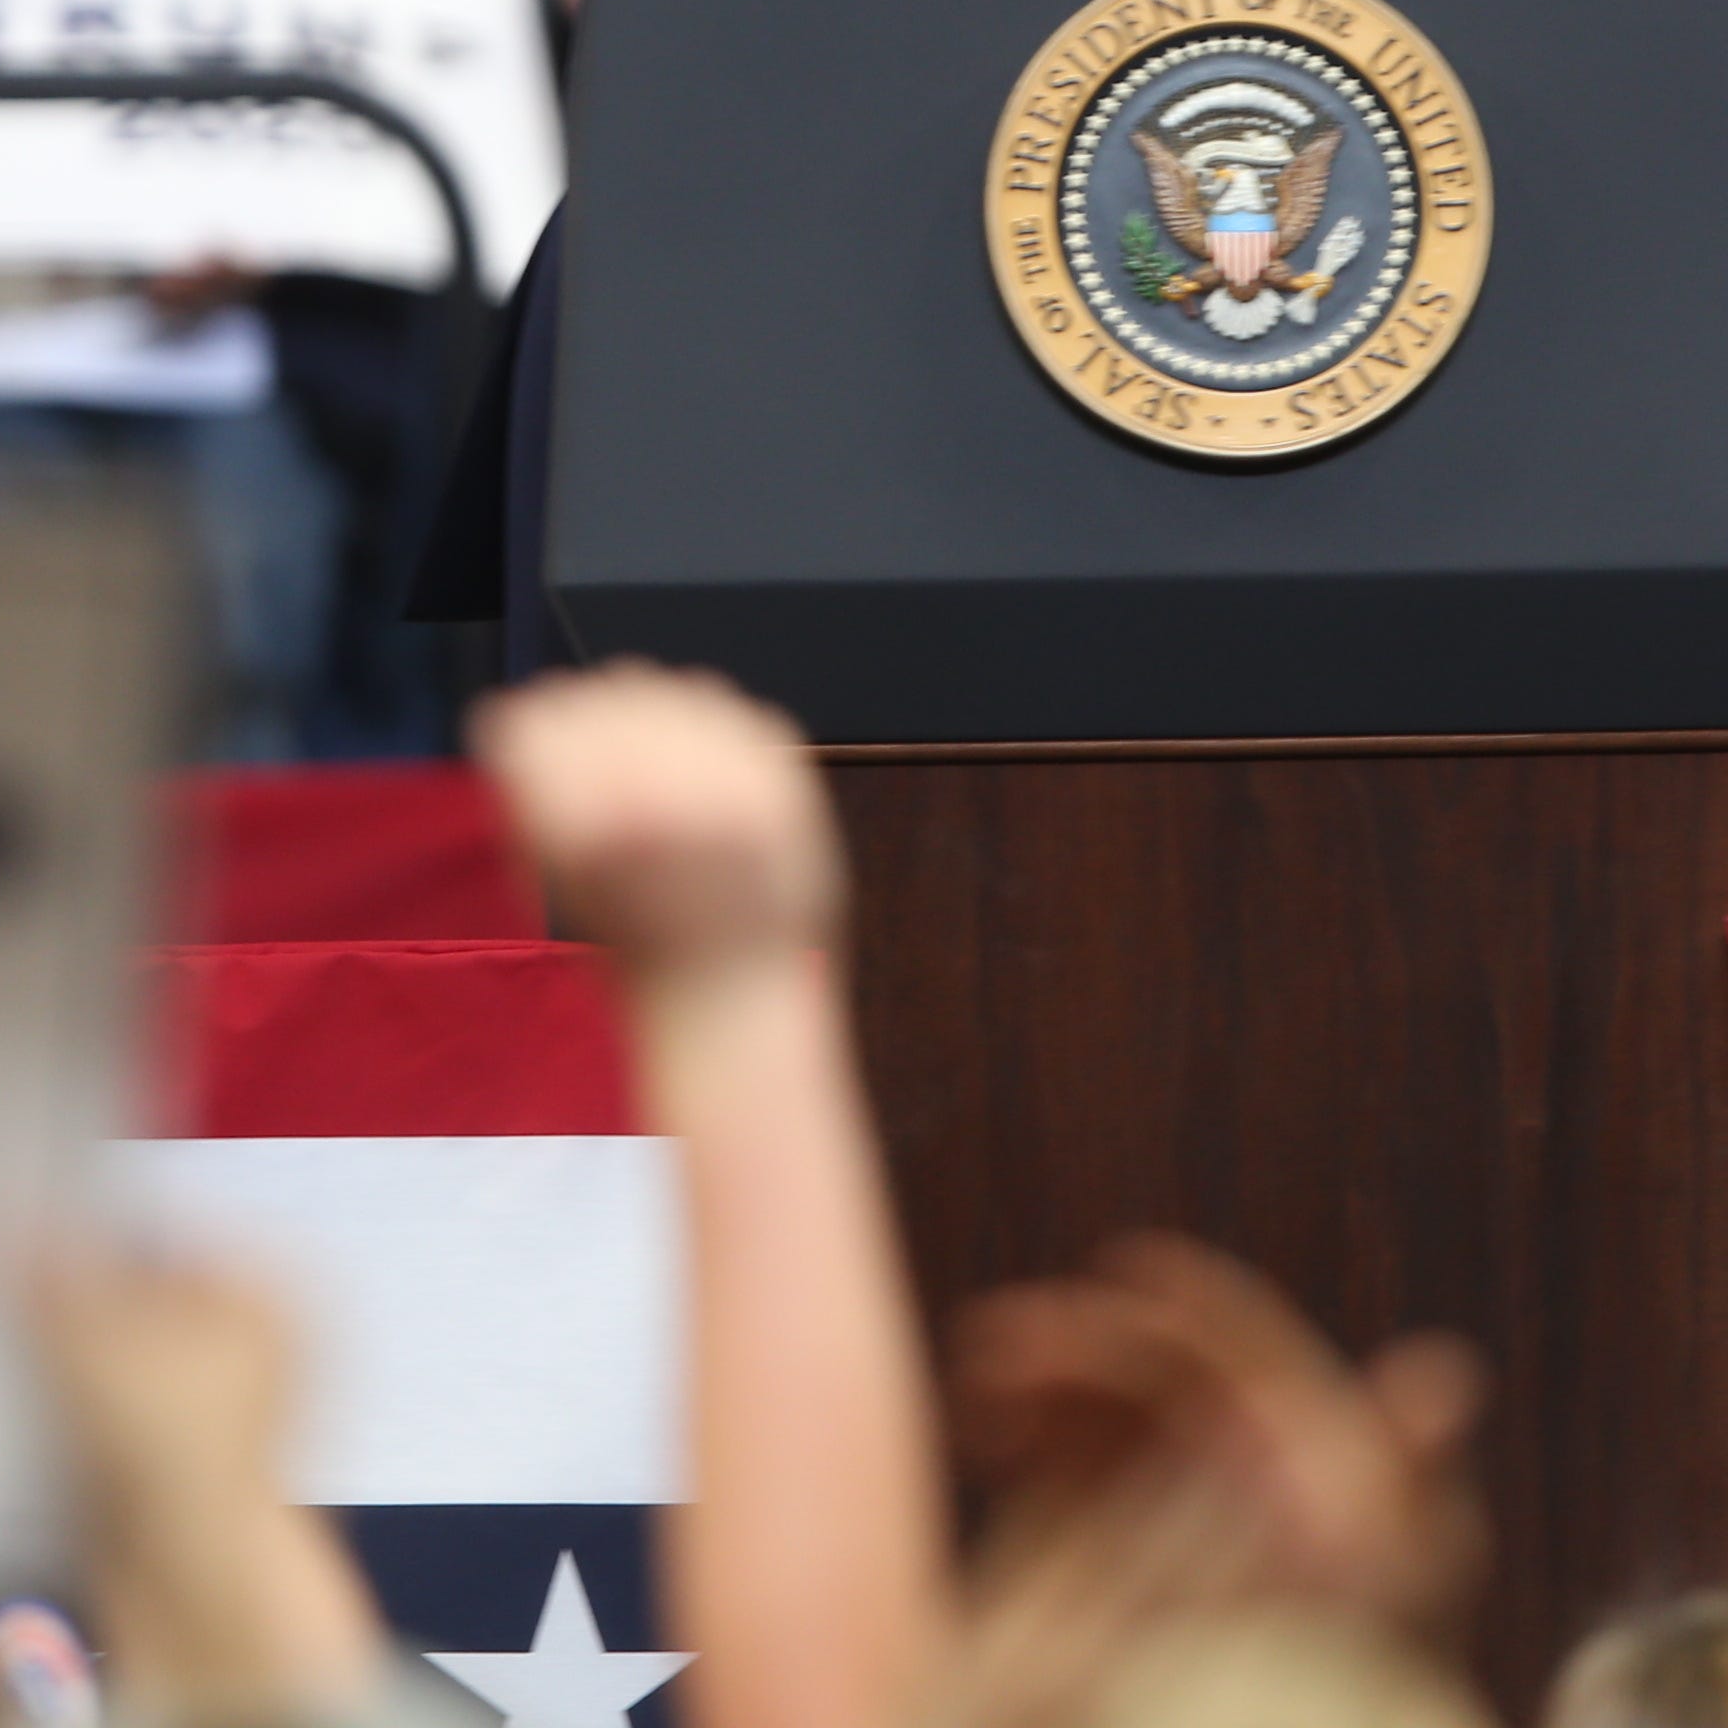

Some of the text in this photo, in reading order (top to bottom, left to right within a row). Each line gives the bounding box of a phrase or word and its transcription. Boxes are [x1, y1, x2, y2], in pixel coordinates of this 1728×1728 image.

[1368, 37, 1472, 233] UNITED
[1012, 216, 1044, 286] THE
[1033, 292, 1070, 335] OF
[1287, 280, 1452, 432] STATES
[1075, 332, 1196, 432] SEAL
